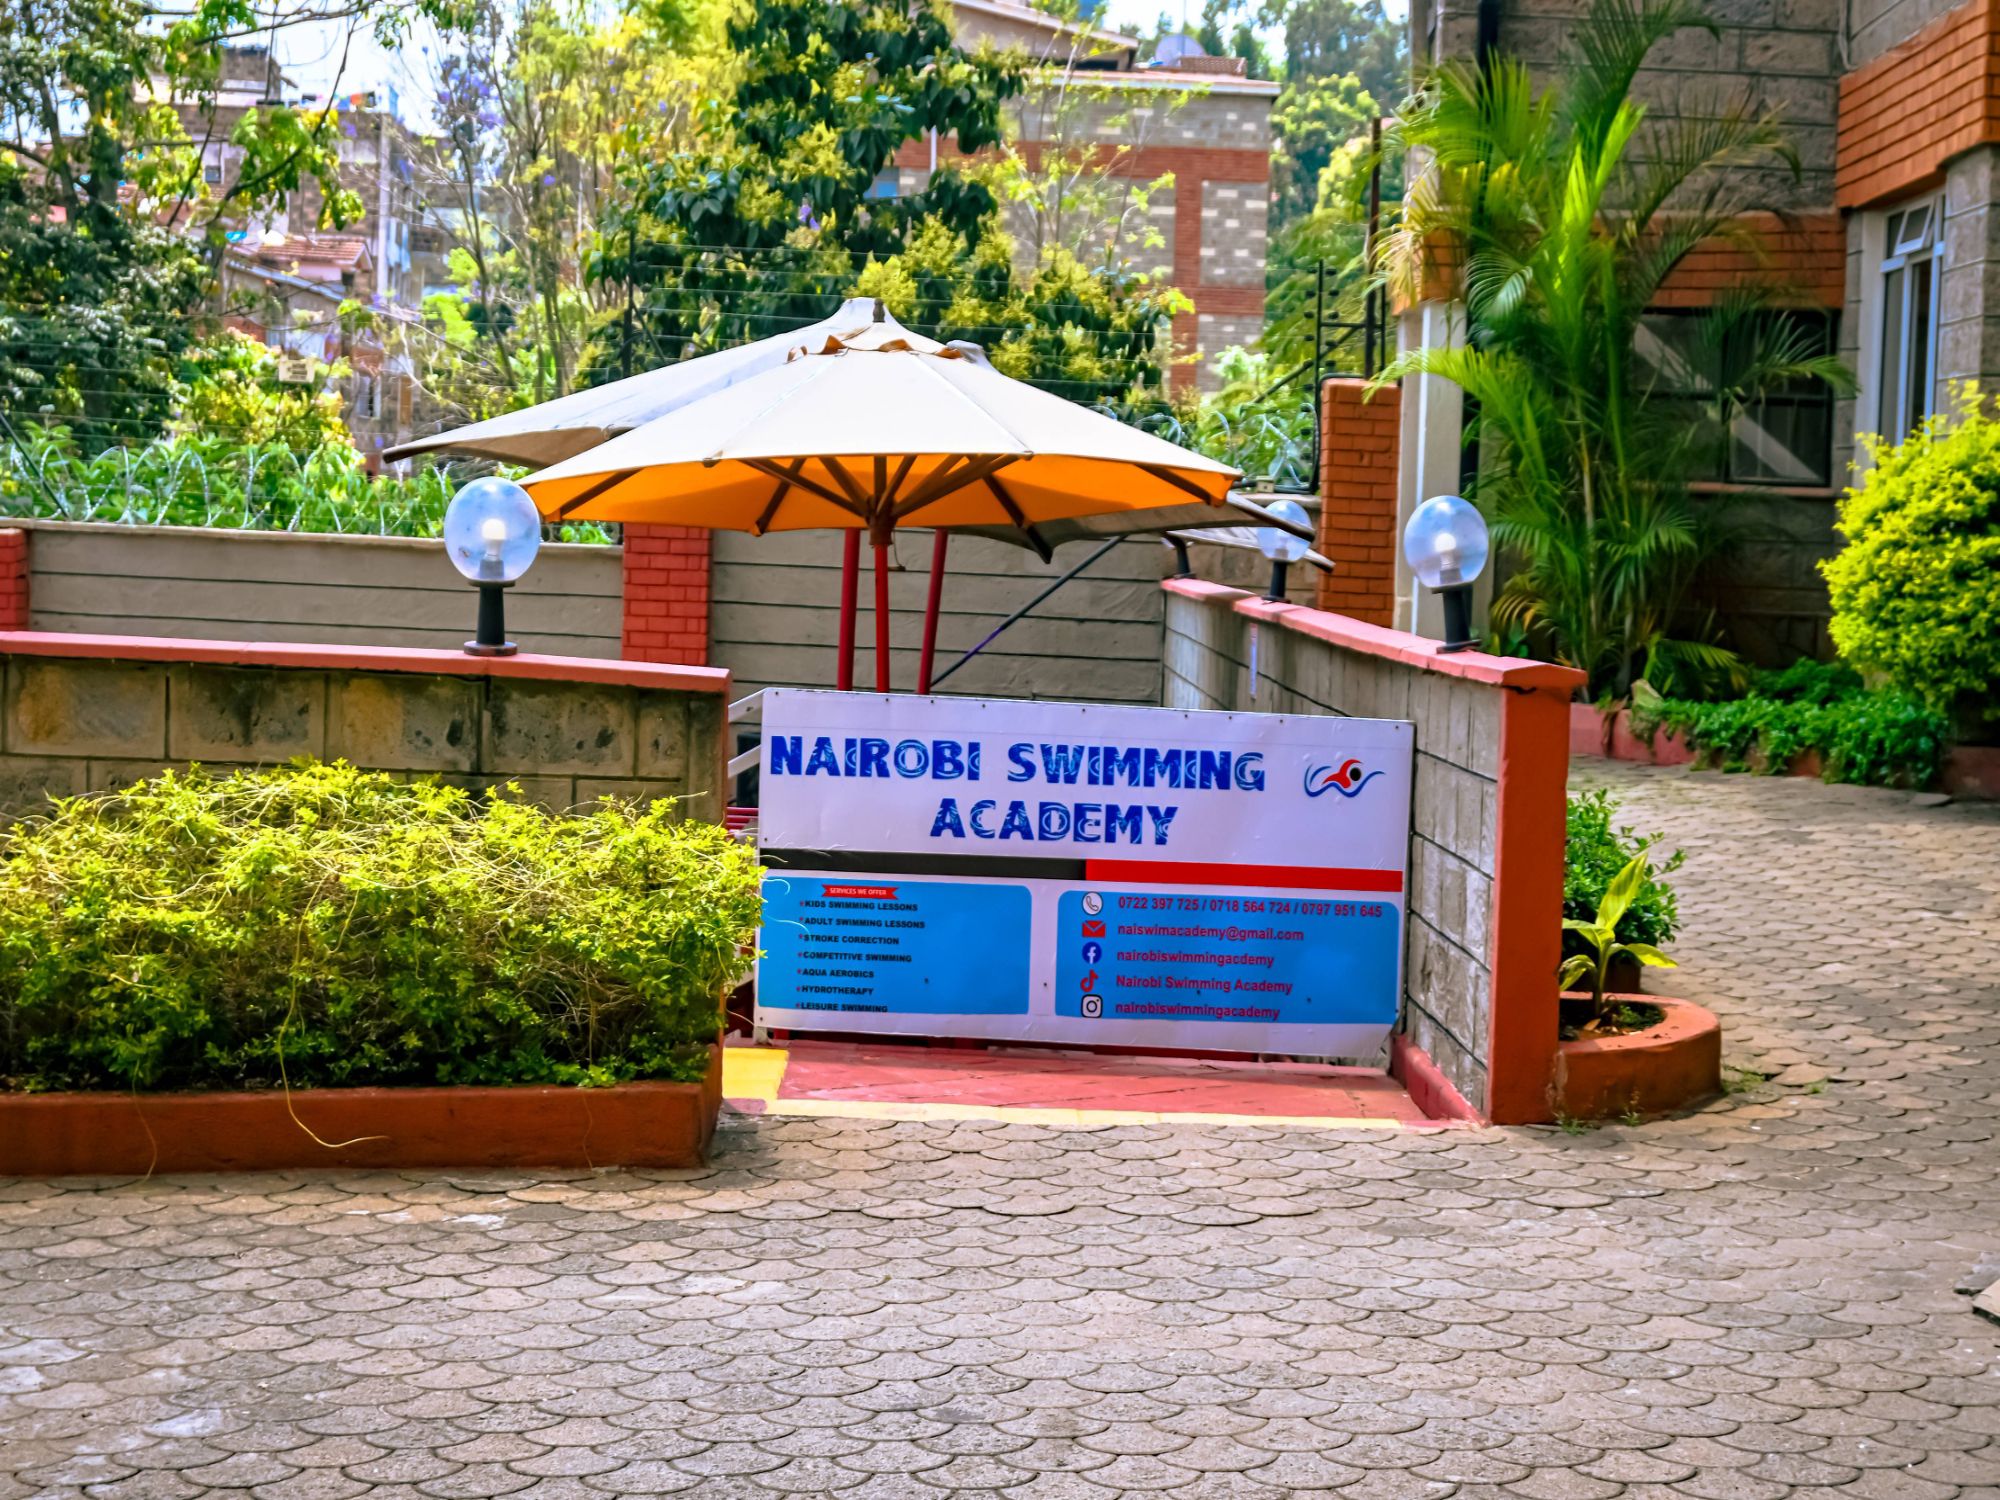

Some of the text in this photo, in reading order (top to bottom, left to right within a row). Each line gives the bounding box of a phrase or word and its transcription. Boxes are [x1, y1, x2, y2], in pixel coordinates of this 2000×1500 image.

[770, 735, 1265, 792] NAIROBI SWIMMING
[929, 798, 1179, 845] ACADEMY
[828, 902, 874, 910] SWIMMING
[1119, 896, 1147, 909] 0722
[1152, 898, 1173, 910] 397
[1178, 899, 1199, 910] 725
[1210, 900, 1238, 912] 0718
[1244, 901, 1265, 913] 564
[1269, 902, 1290, 914] 724
[1302, 903, 1330, 916] 0797
[1334, 904, 1356, 916] 951
[1360, 905, 1382, 917] 645
[836, 918, 882, 927] SWIMMING
[1118, 924, 1303, 942] naiswimacademy@gmail.com
[842, 936, 899, 944] CORRECTION
[803, 952, 912, 962] COMPETITIVE SWIMMING
[1117, 951, 1274, 967] nairobiswimmingacdemy
[830, 970, 874, 978] AEROBICS
[802, 986, 874, 995] HYDROTHERAPY
[1116, 975, 1293, 995] Nairobi Swimming Academy
[801, 1002, 888, 1012] LEISURE SWIMMING
[1116, 1001, 1280, 1020] nairobiswimmingacademy
